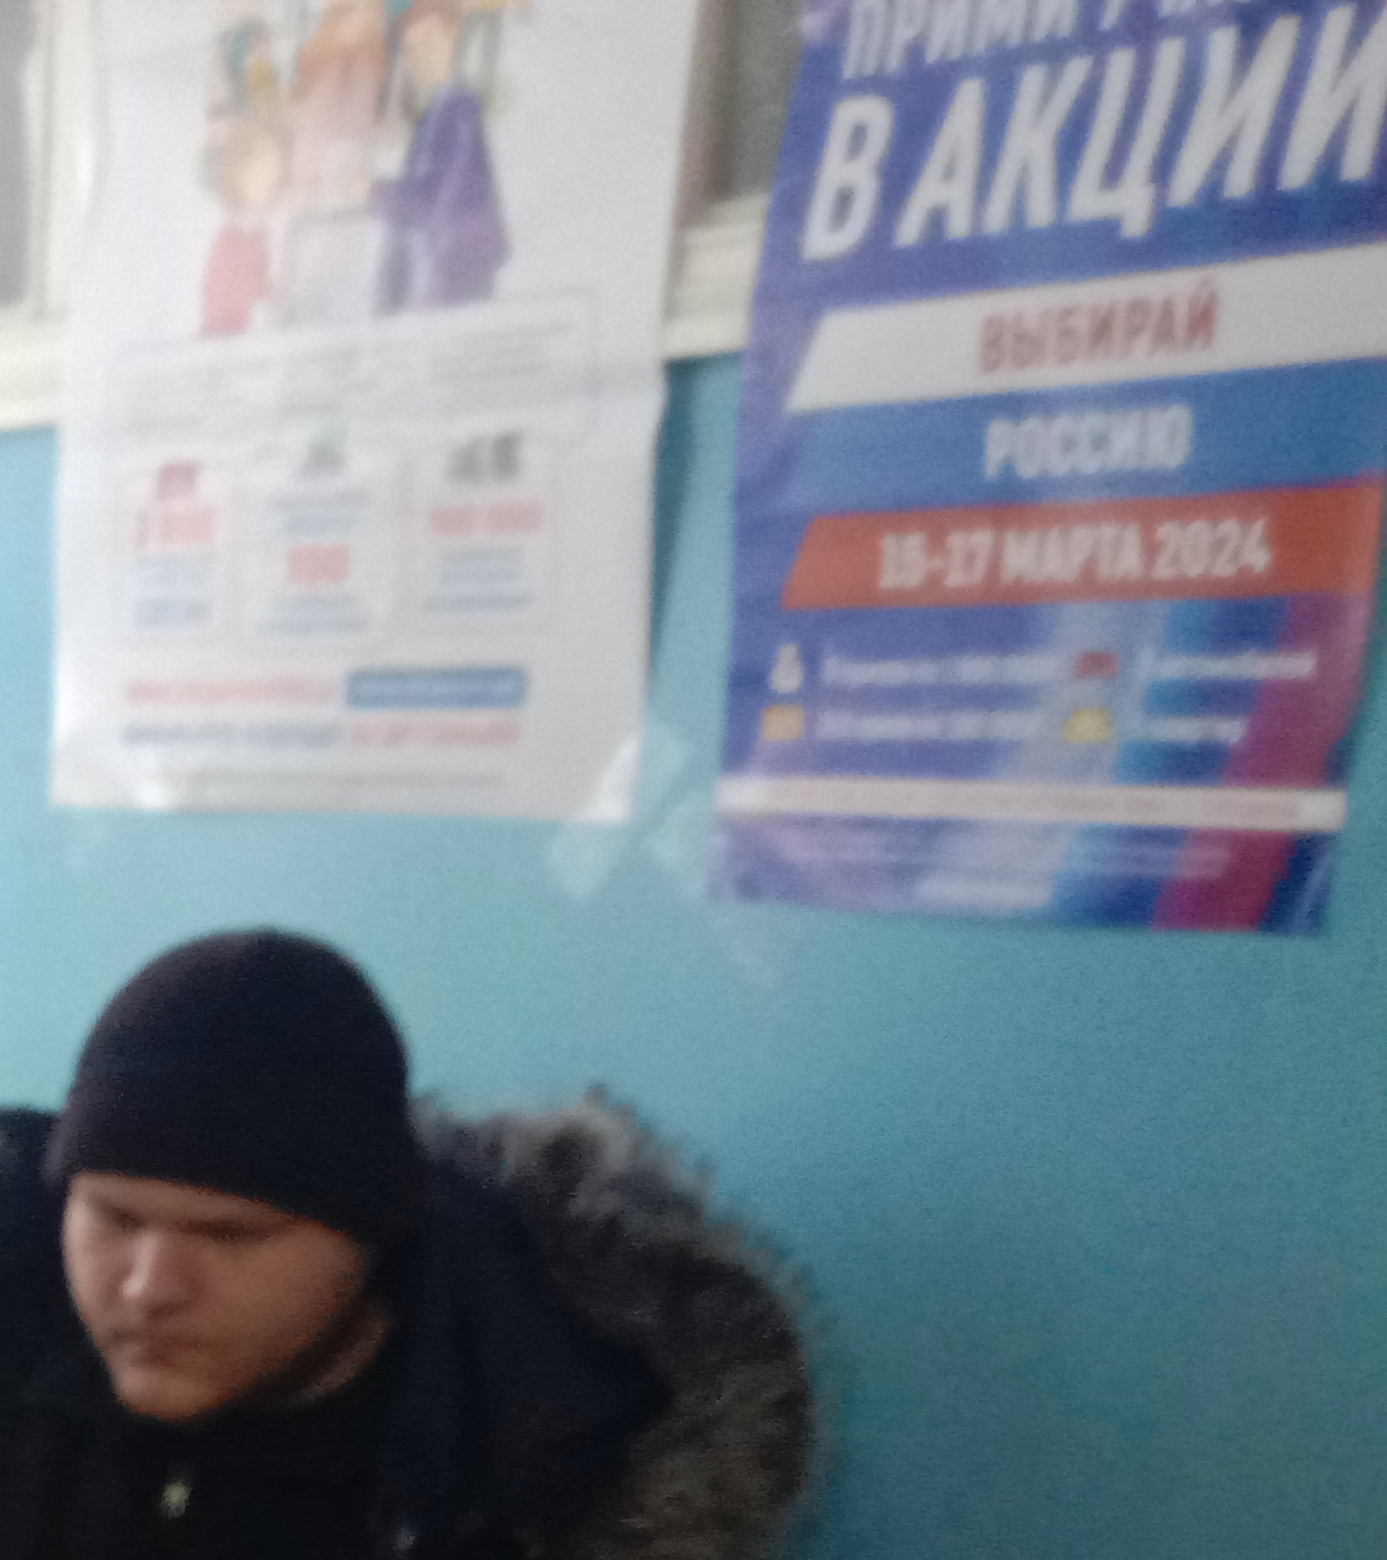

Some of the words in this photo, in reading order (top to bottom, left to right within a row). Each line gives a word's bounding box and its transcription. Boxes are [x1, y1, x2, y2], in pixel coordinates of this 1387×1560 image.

[800, 94, 895, 264] В
[892, 2, 1387, 249] АКЦИИ
[978, 276, 1221, 376] ВЫБИРАЙ
[983, 401, 1194, 480] РОССИЮ
[999, 520, 1144, 583] МАРТА
[1149, 516, 1274, 580] 2024
